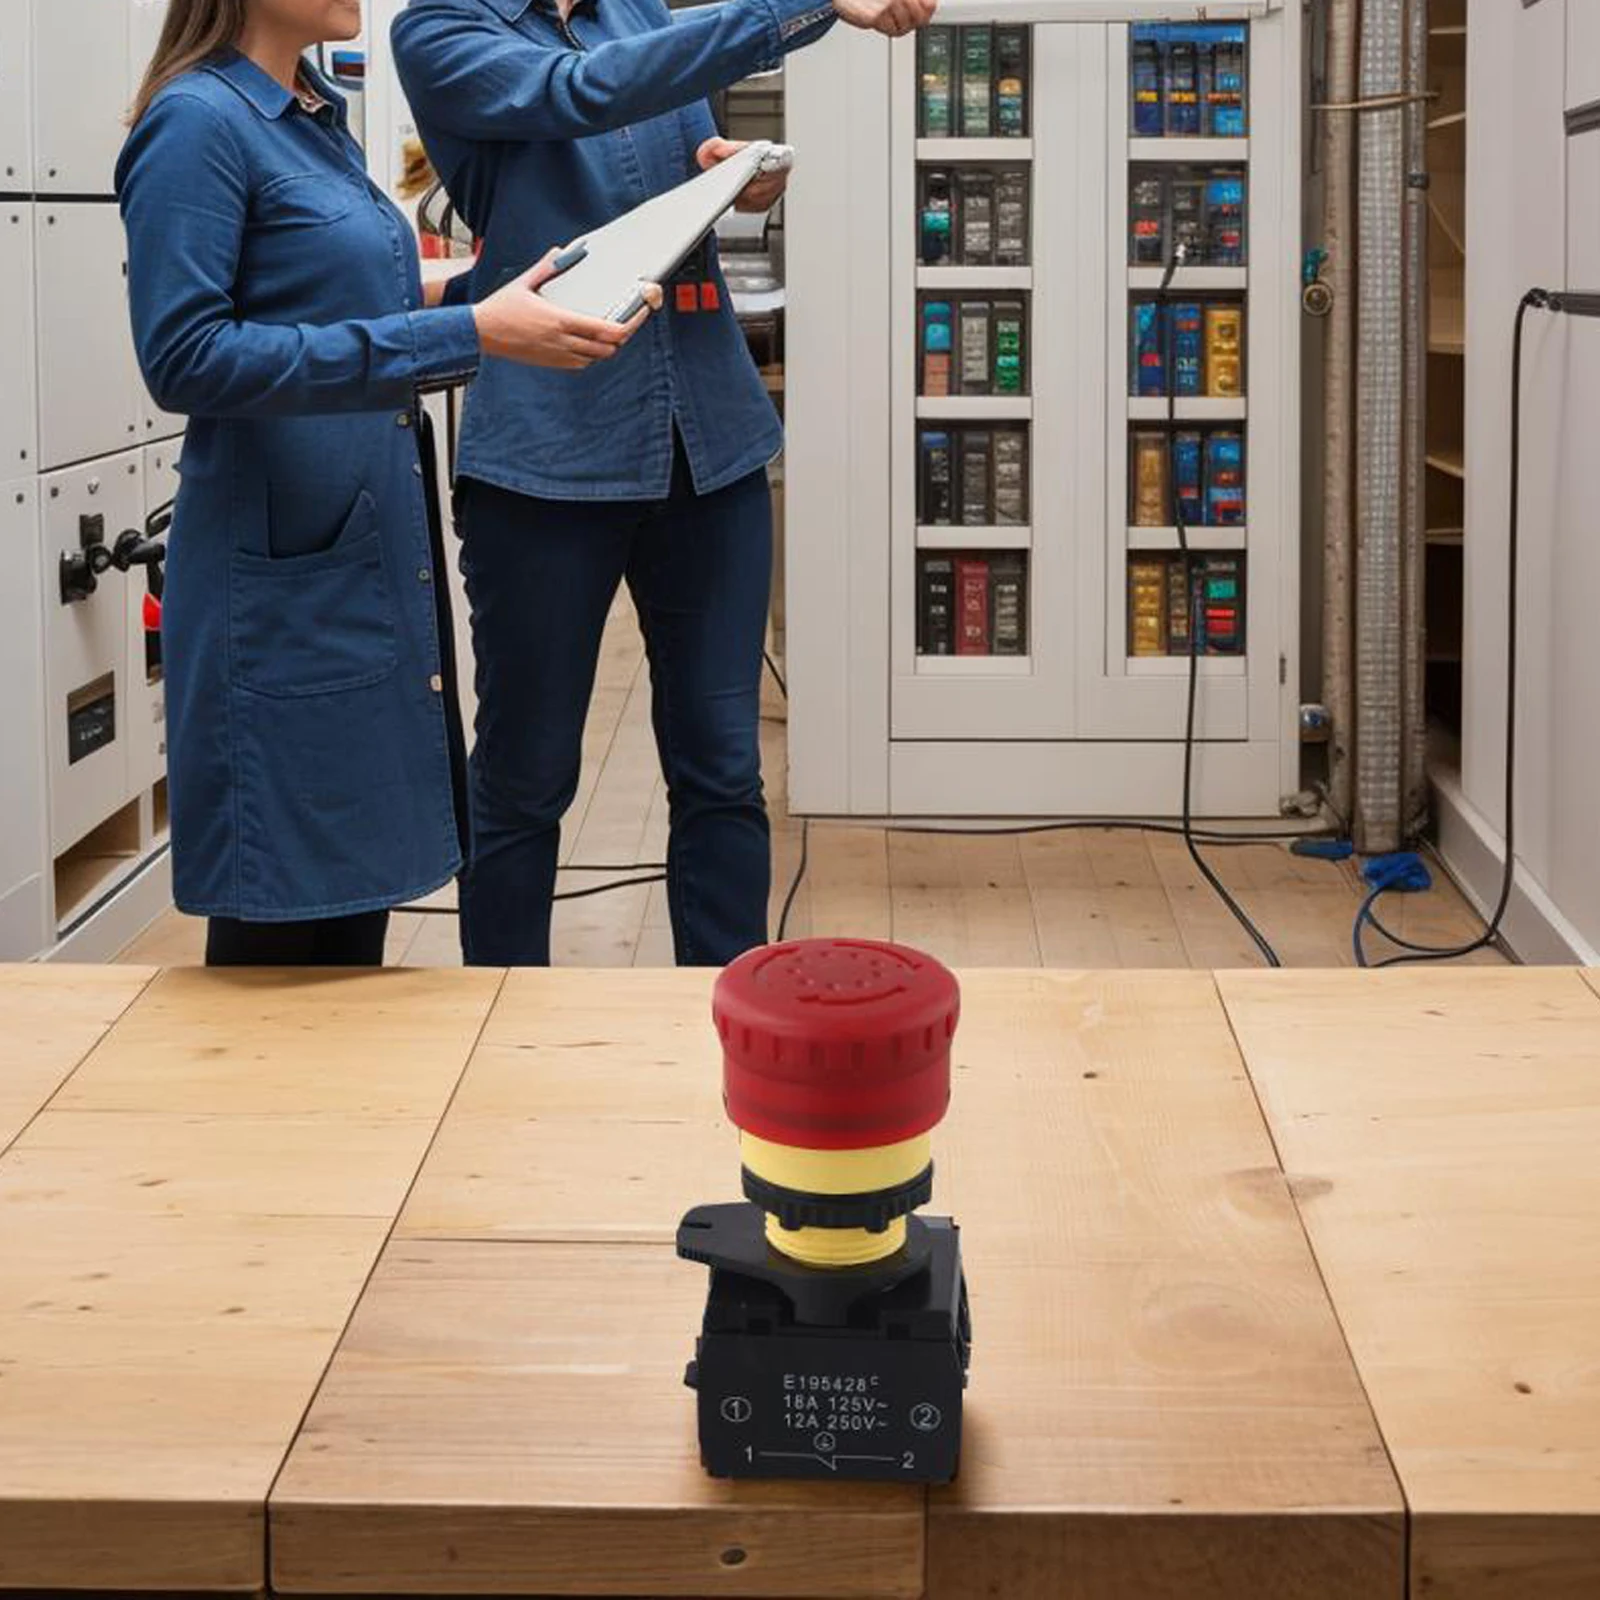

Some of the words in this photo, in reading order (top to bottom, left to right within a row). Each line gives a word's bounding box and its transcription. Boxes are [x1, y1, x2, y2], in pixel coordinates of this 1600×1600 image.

[783, 1412, 819, 1429] 12A
[744, 1446, 753, 1463] 1
[901, 1450, 915, 1469] 2
